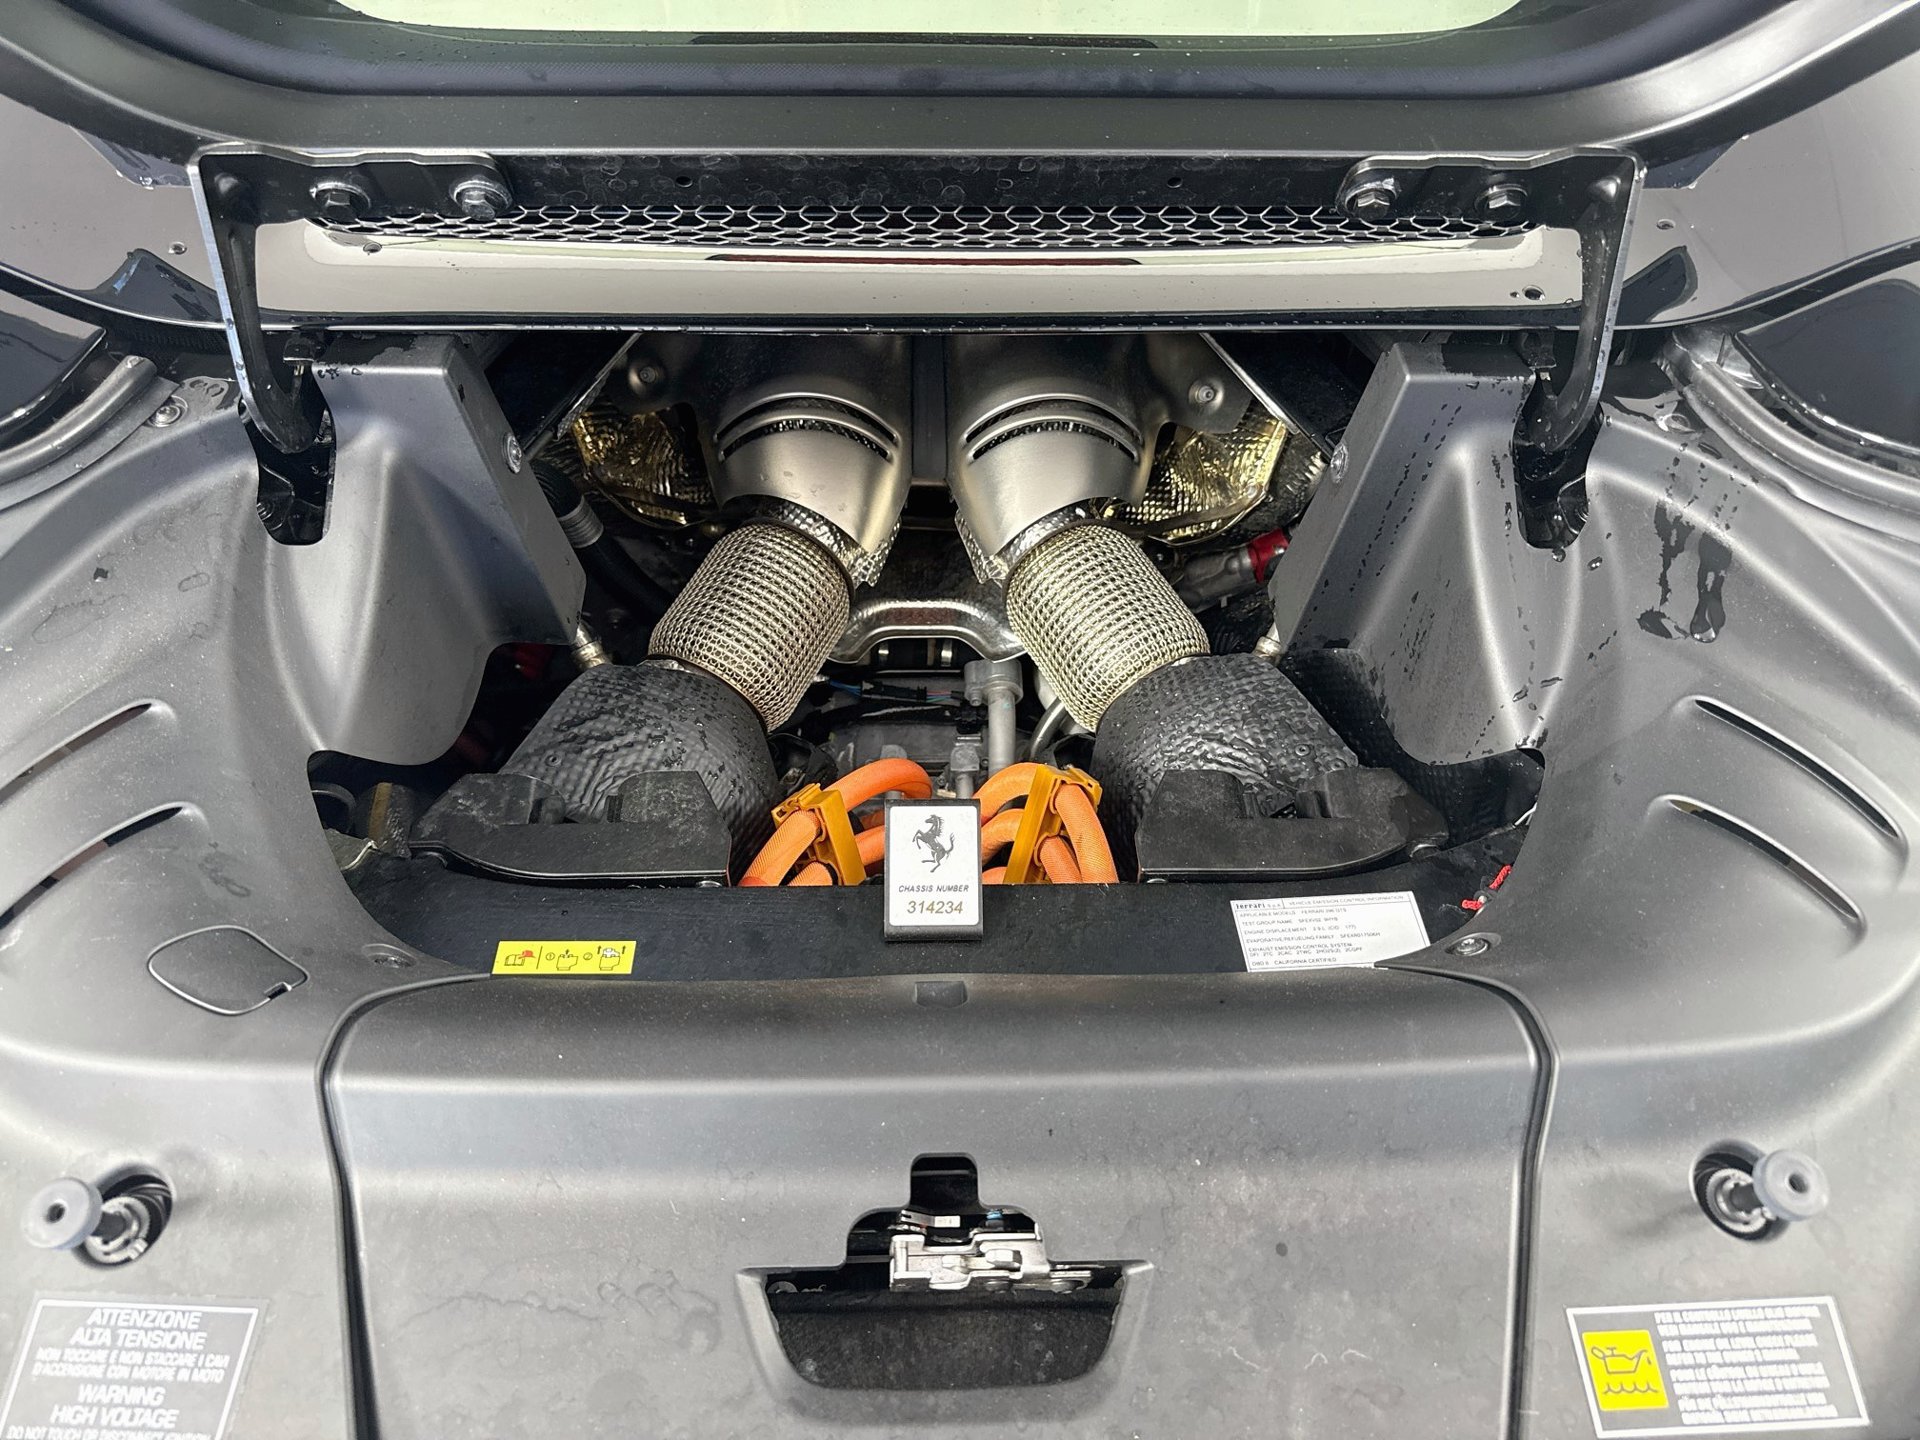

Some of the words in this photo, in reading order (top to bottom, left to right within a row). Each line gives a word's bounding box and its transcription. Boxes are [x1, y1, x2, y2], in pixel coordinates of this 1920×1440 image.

[899, 885, 933, 893] CHASSIS
[907, 900, 963, 914] 314234
[87, 1308, 203, 1330] ATTENZIONE
[70, 1327, 112, 1346] ALTA
[116, 1330, 208, 1350] TENSIONE
[192, 1368, 225, 1384] MOTO
[77, 1384, 166, 1406] WARNING
[50, 1405, 96, 1426] HIGH
[99, 1408, 180, 1429] VOLTAGE
